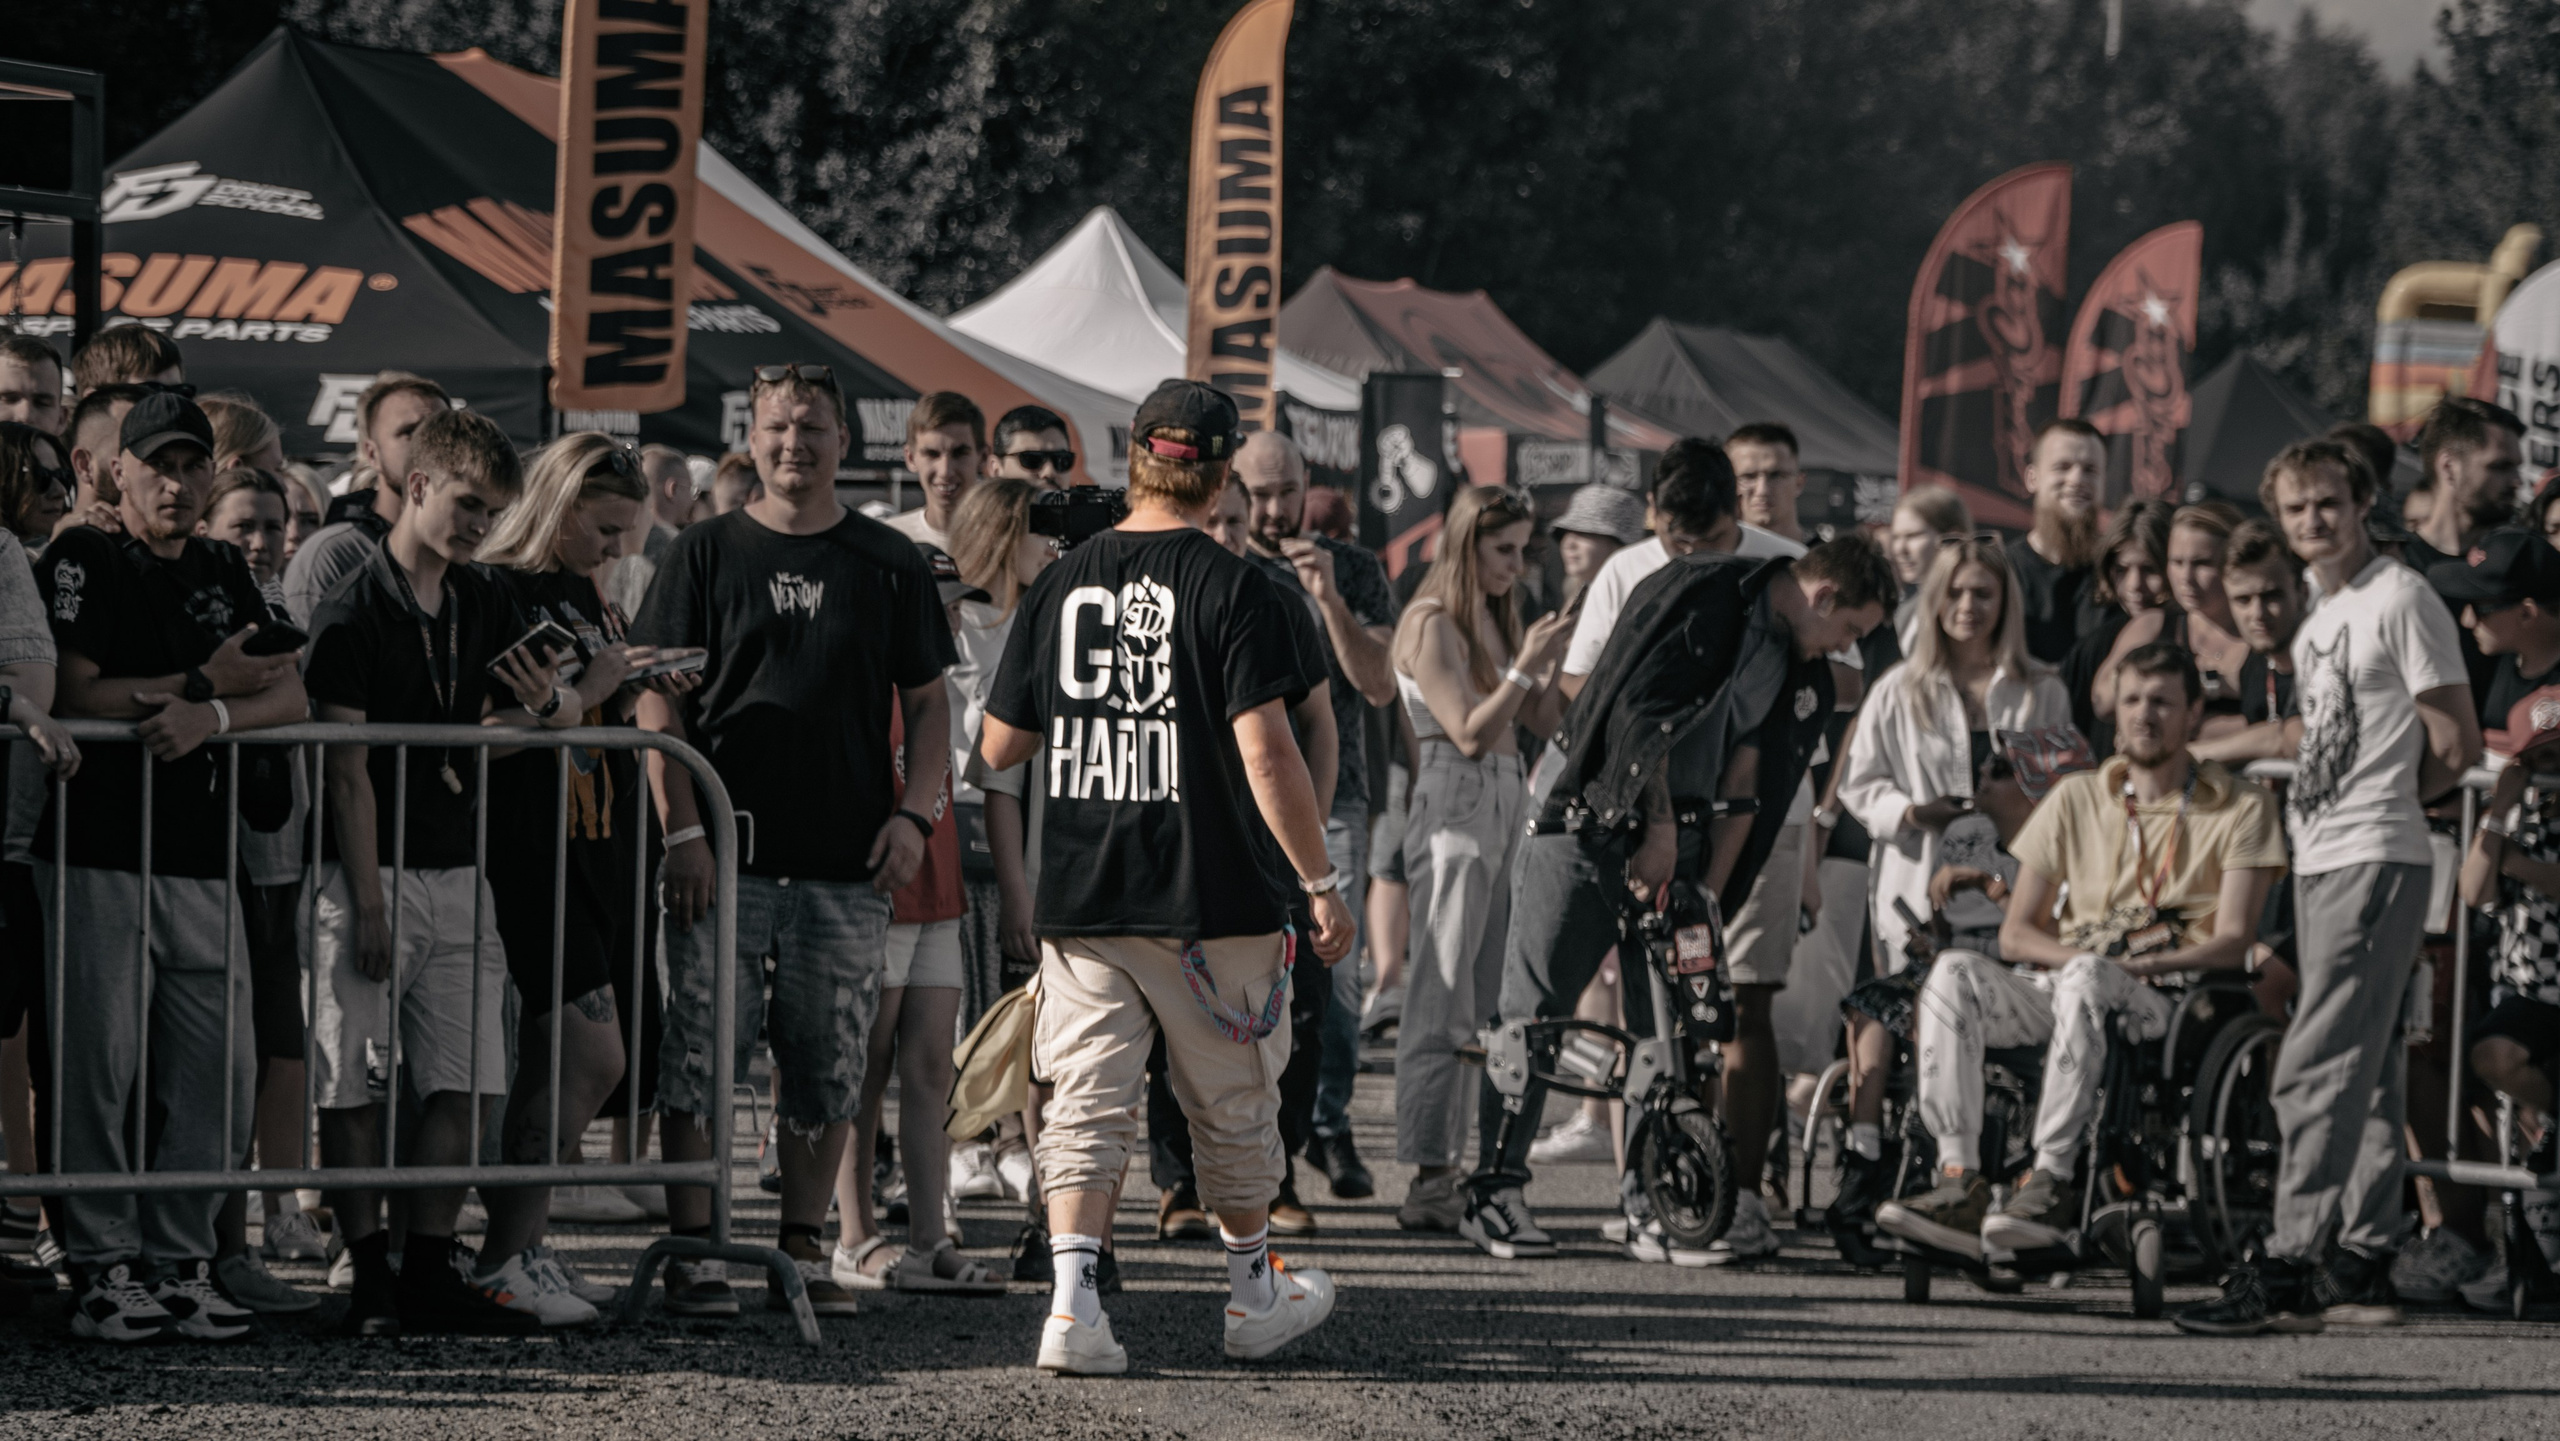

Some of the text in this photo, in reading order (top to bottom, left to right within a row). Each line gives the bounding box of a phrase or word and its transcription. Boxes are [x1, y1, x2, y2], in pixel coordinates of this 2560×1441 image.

[0, 252, 364, 325] ASUMA
[172, 317, 333, 343] PARTS
[769, 579, 824, 620] VENOM
[1050, 715, 1180, 803] HARD!
